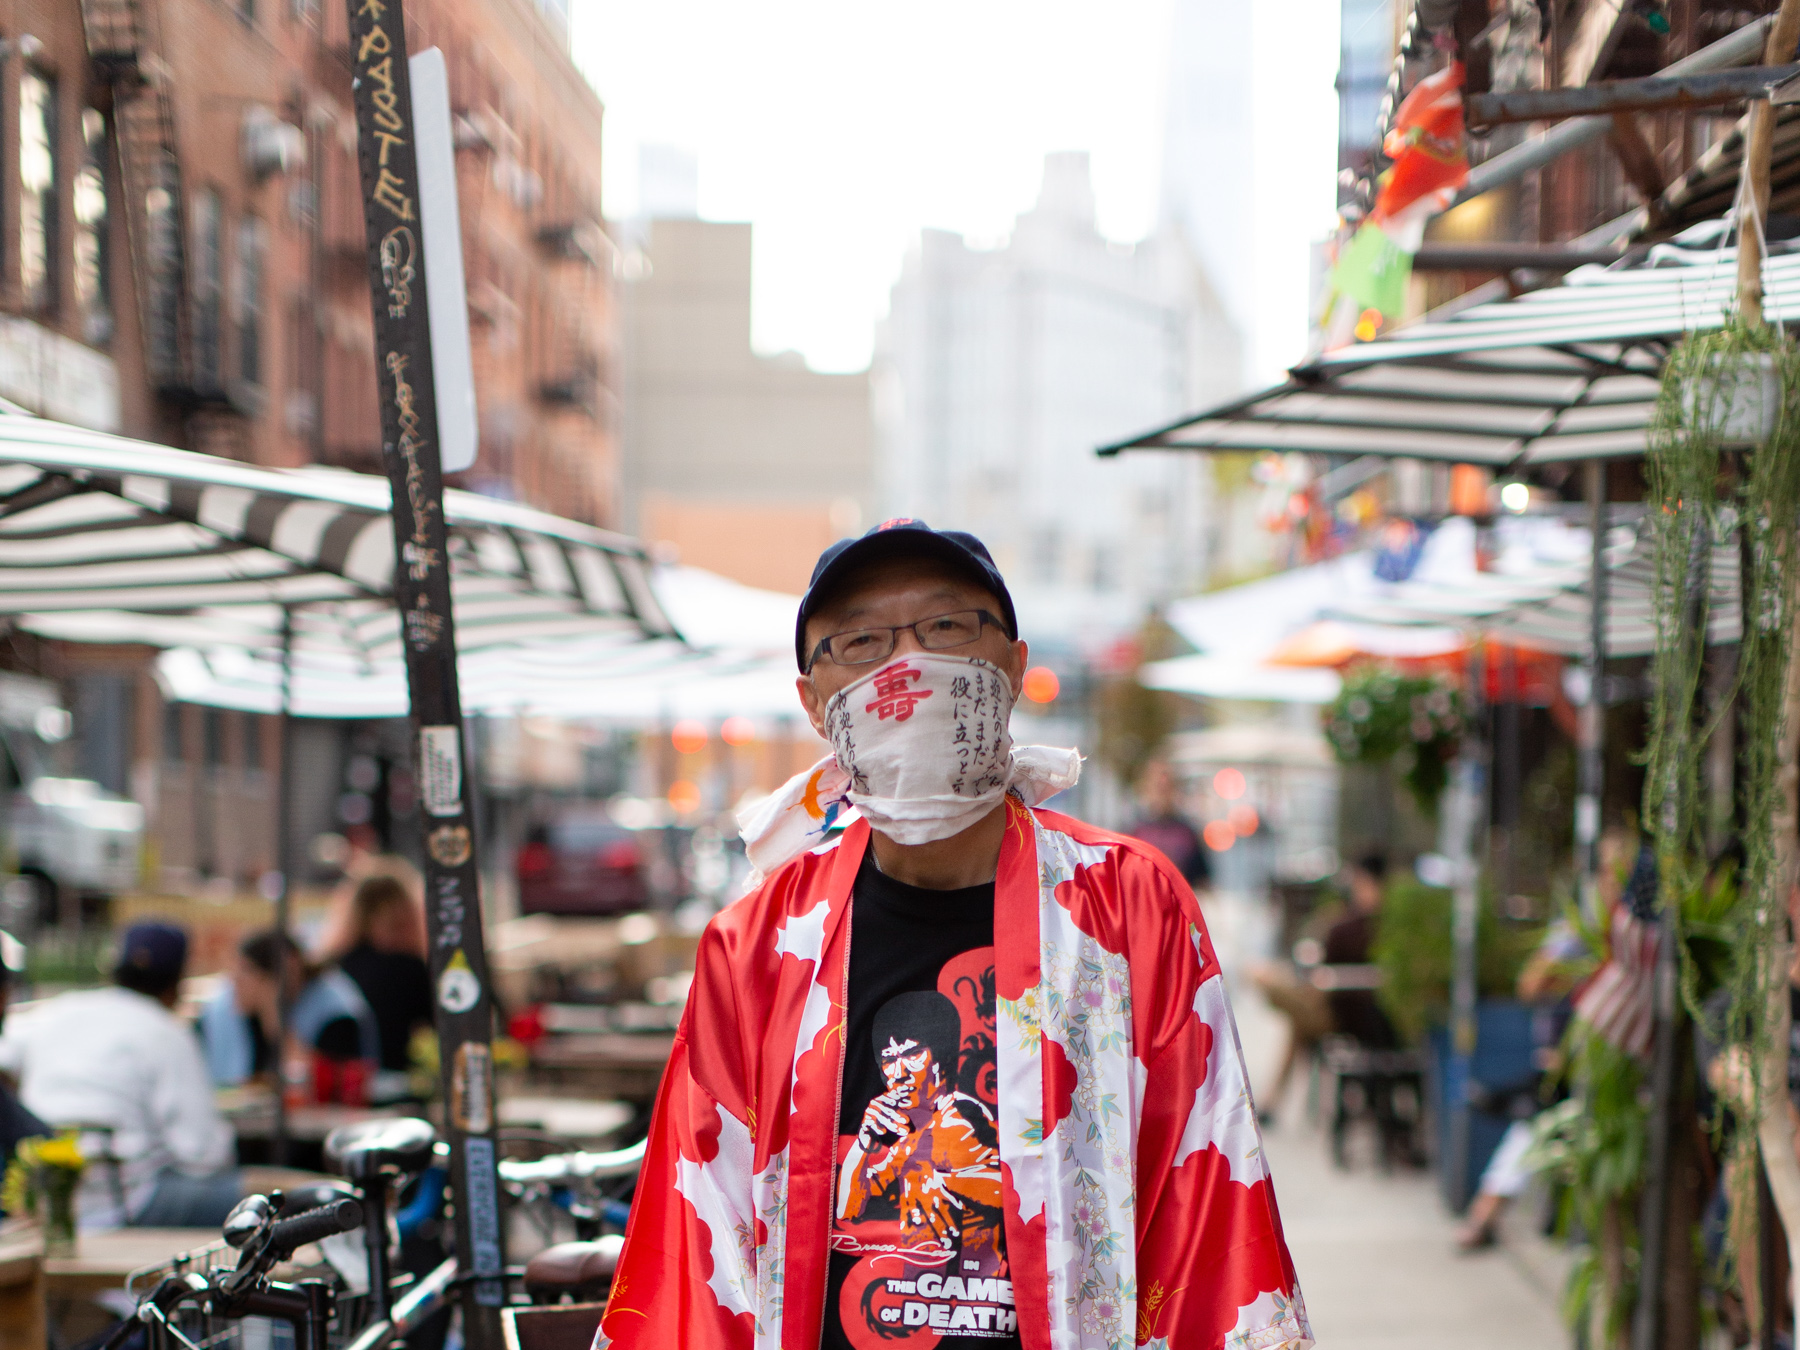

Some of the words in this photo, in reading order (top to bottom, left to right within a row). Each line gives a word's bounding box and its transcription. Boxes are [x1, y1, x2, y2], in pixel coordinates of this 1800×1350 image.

[963, 1259, 980, 1271] IN
[887, 1279, 917, 1294] THE
[916, 1272, 1016, 1305] GAME
[880, 1308, 901, 1323] OF
[902, 1301, 1018, 1333] DEATH
